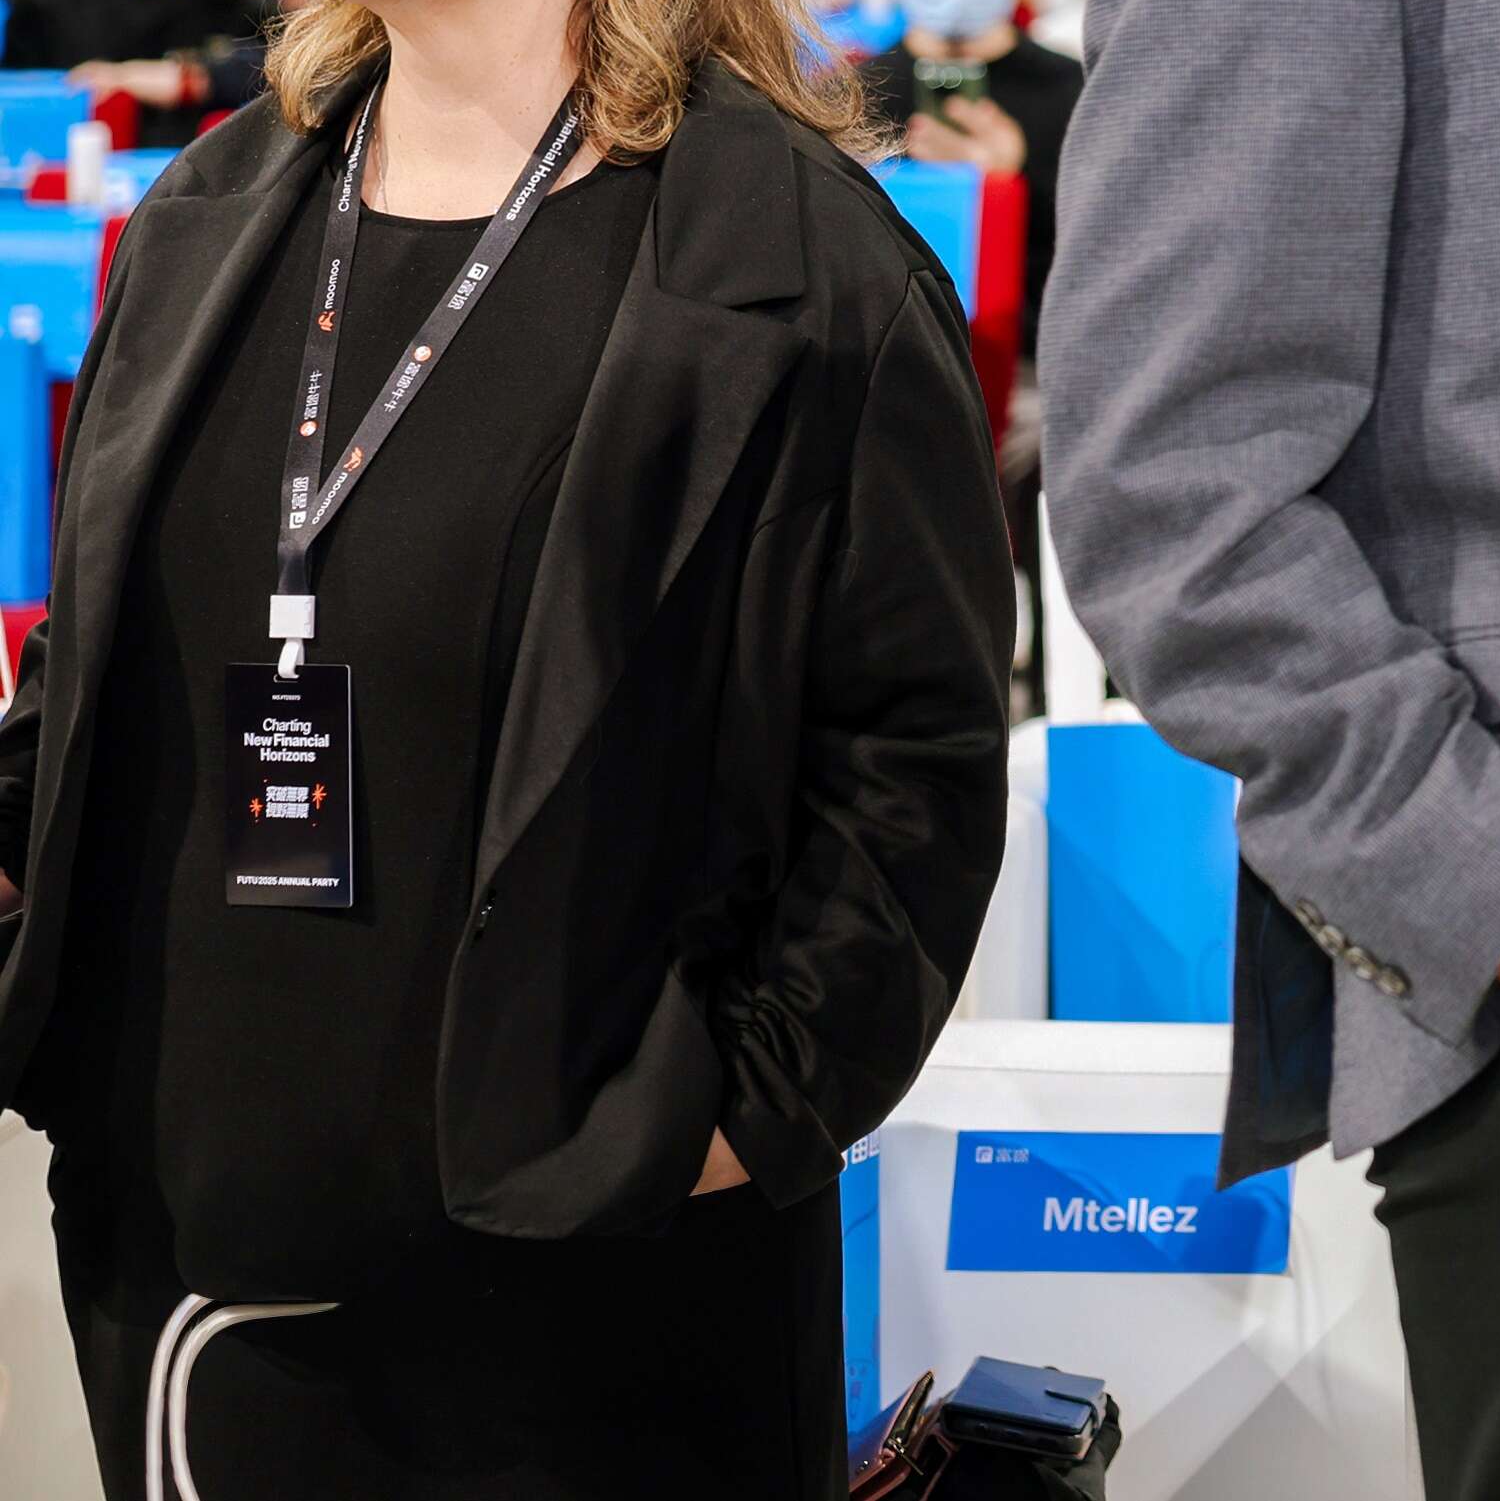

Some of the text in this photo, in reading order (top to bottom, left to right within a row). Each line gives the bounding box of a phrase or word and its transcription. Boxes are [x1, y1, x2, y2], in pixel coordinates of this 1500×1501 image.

[506, 109, 580, 222] inancial Horizons
[324, 258, 341, 310] moomoo
[303, 369, 324, 421] 富途牛牛
[291, 476, 310, 511] 富途
[311, 471, 349, 526] moomoo
[243, 732, 330, 748] New Financial
[262, 717, 312, 734] Charting
[259, 748, 316, 763] Horizons
[236, 875, 260, 885] FUTU
[278, 877, 311, 887] ANNUAL
[312, 878, 340, 888] PARTY
[1042, 1196, 1199, 1234] Mtellez
